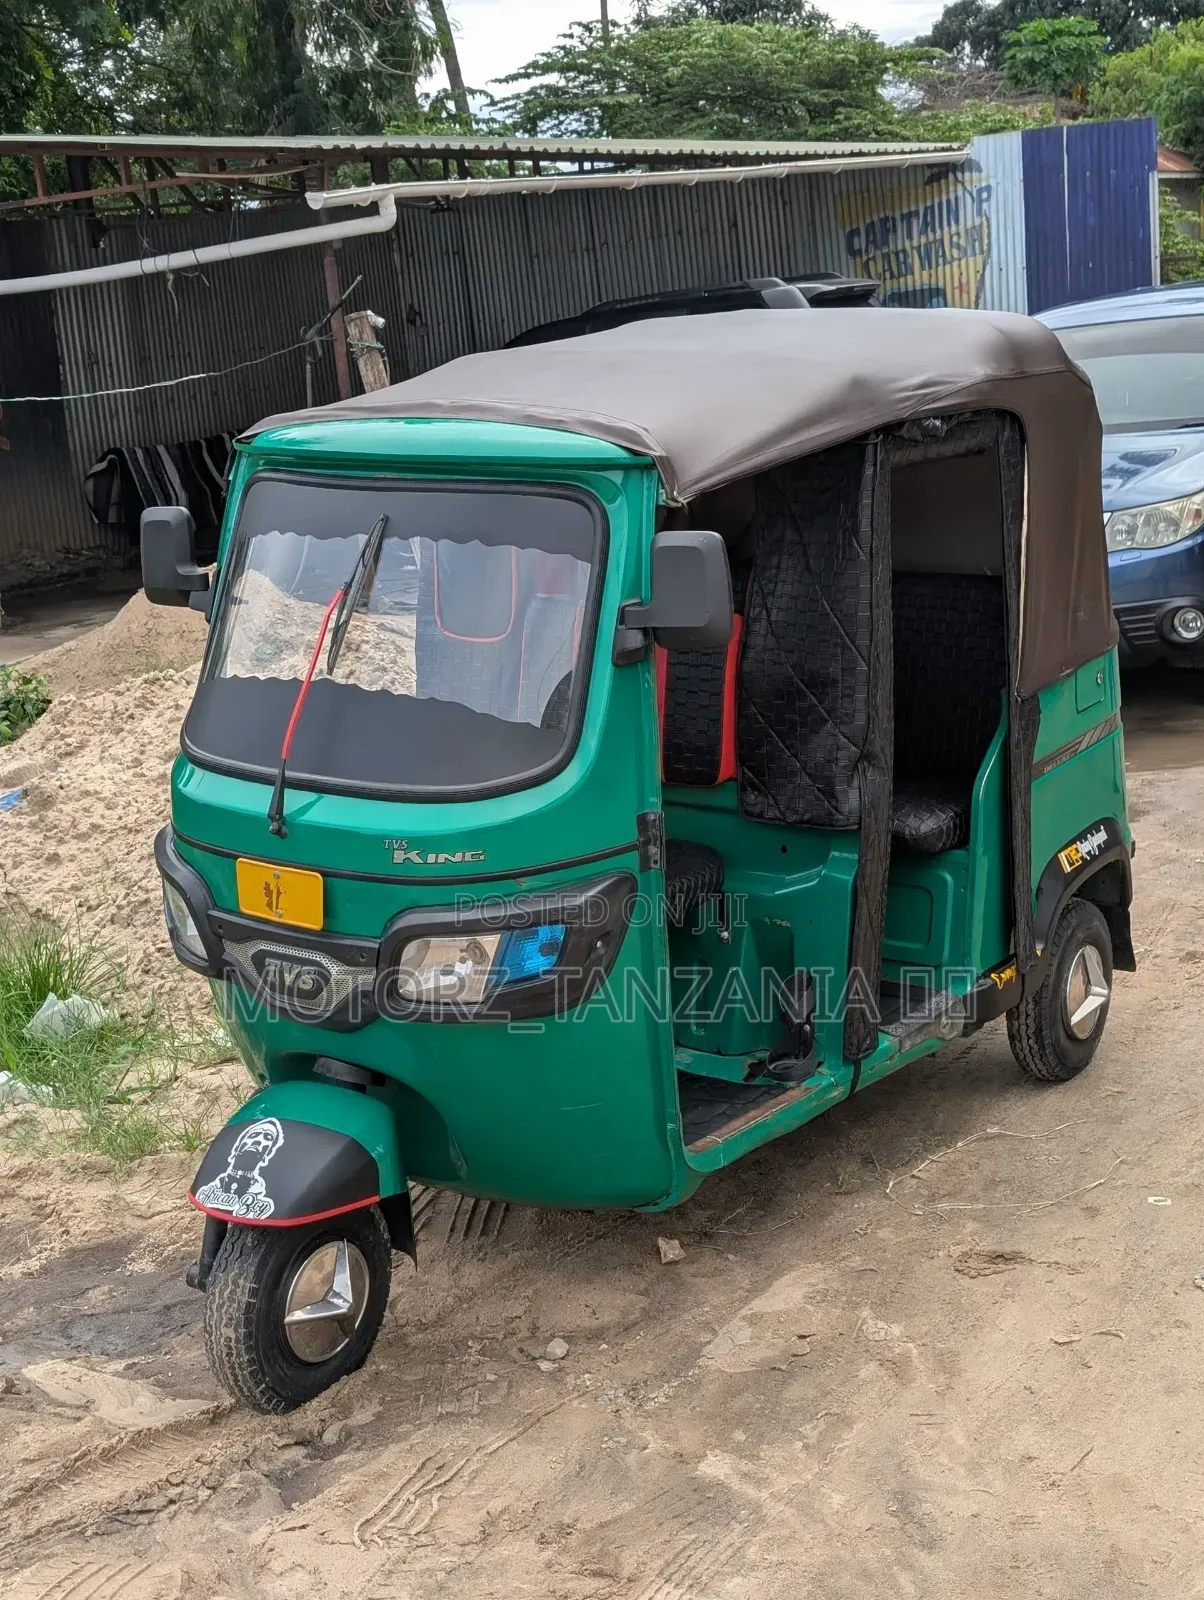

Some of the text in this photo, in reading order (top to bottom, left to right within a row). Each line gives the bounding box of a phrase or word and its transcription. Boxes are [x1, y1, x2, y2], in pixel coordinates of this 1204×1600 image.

[846, 194, 960, 258] CAPTAIN
[383, 839, 409, 850] TVS
[265, 957, 318, 990] TVS
